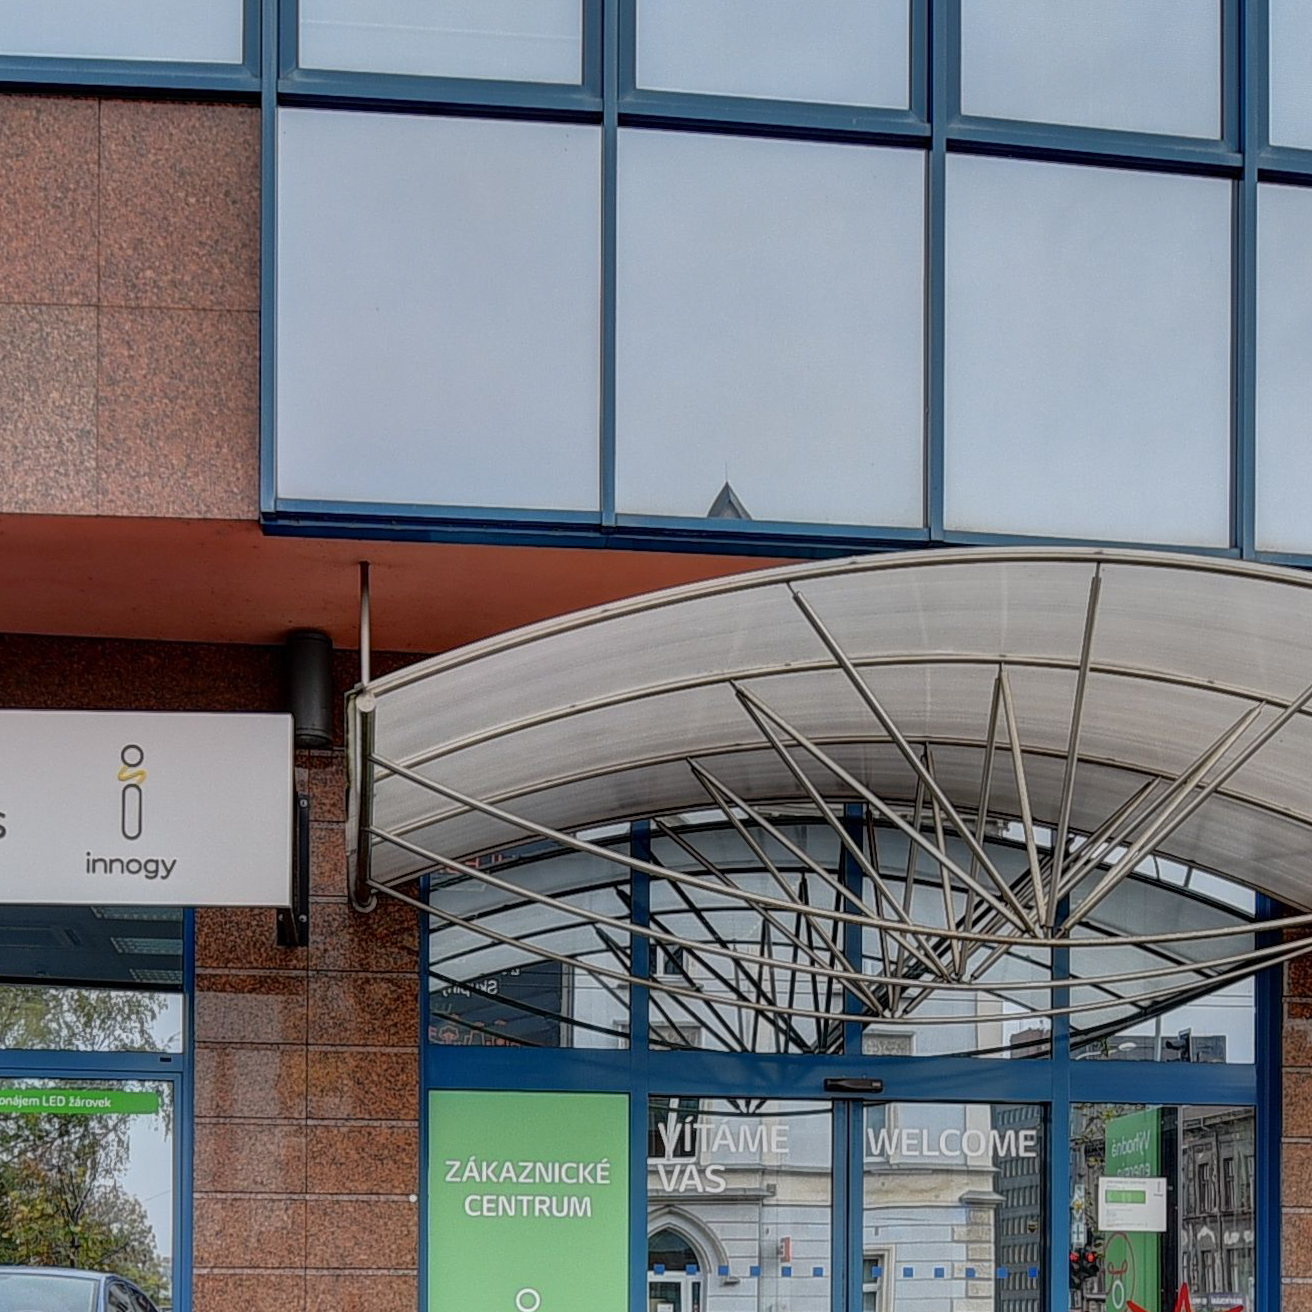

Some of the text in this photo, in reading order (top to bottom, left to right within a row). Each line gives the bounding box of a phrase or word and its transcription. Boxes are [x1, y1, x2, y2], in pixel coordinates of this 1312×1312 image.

[85, 852, 177, 879] innogy
[42, 1096, 65, 1106] LED
[68, 1095, 111, 1108] žárovek
[657, 1116, 789, 1154] VÍTÁME
[867, 1127, 1038, 1158] WELCOME
[445, 1155, 610, 1185] ZÁKAZNICKÉ
[464, 1194, 592, 1217] CENTRUM
